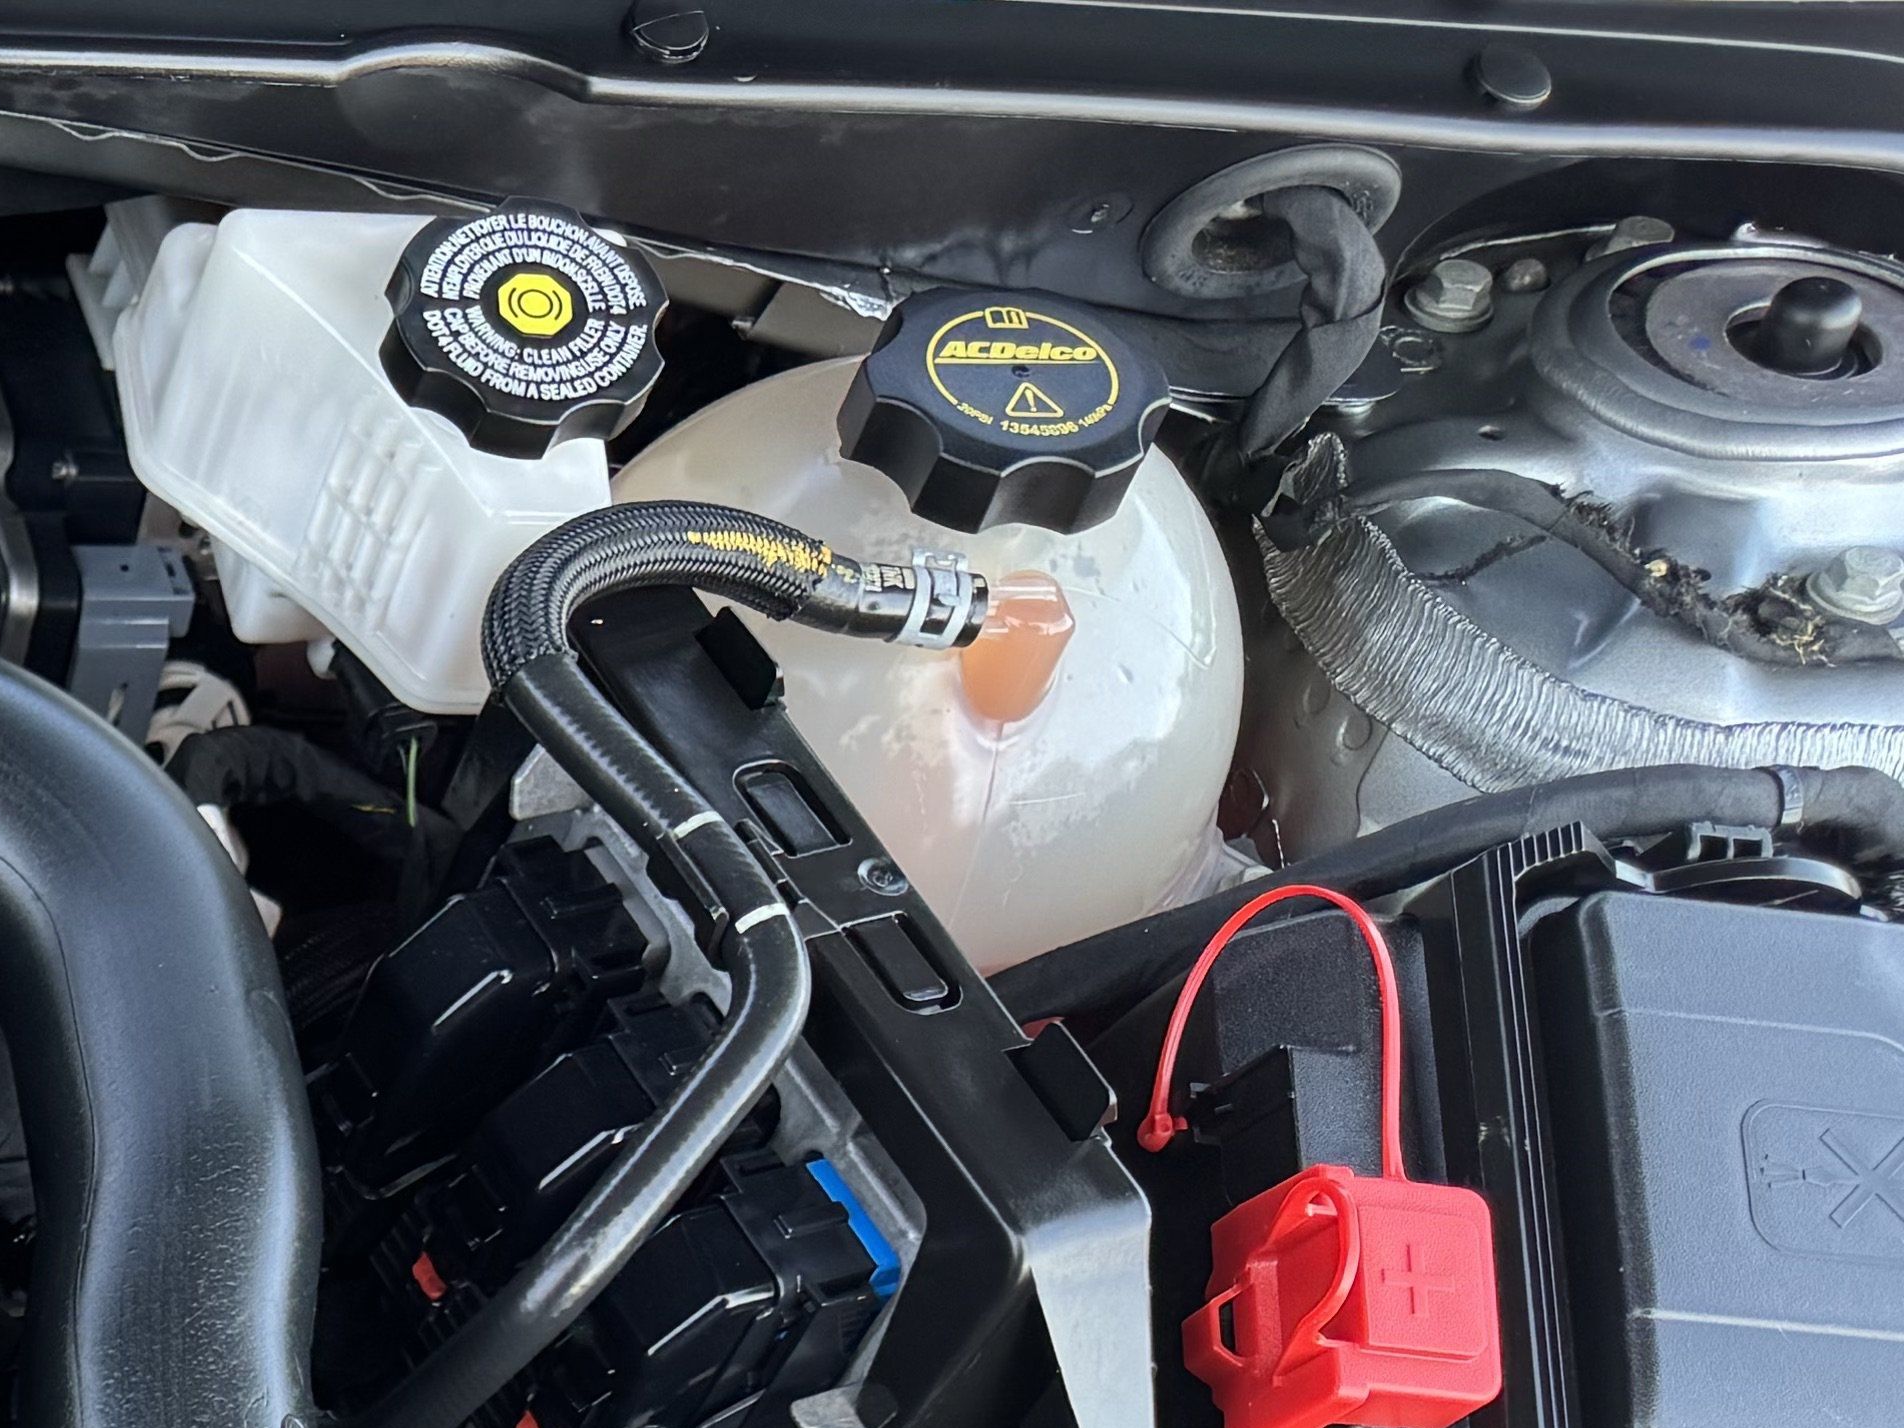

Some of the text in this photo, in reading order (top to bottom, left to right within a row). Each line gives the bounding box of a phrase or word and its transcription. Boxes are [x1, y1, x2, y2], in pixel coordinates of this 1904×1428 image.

[504, 230, 522, 246] DU
[569, 243, 590, 263] DE
[509, 213, 526, 229] LE
[584, 236, 624, 268] AVANT
[444, 308, 470, 334] CAP
[458, 332, 512, 374] BEFORE
[600, 320, 627, 353] ONLY
[465, 305, 605, 365] WARNING: CLEAN FILLER
[940, 340, 1097, 361] ACDelco
[442, 341, 484, 377] FLUID
[481, 369, 527, 397] FROM
[526, 381, 539, 399] A
[539, 376, 597, 401] SEALED
